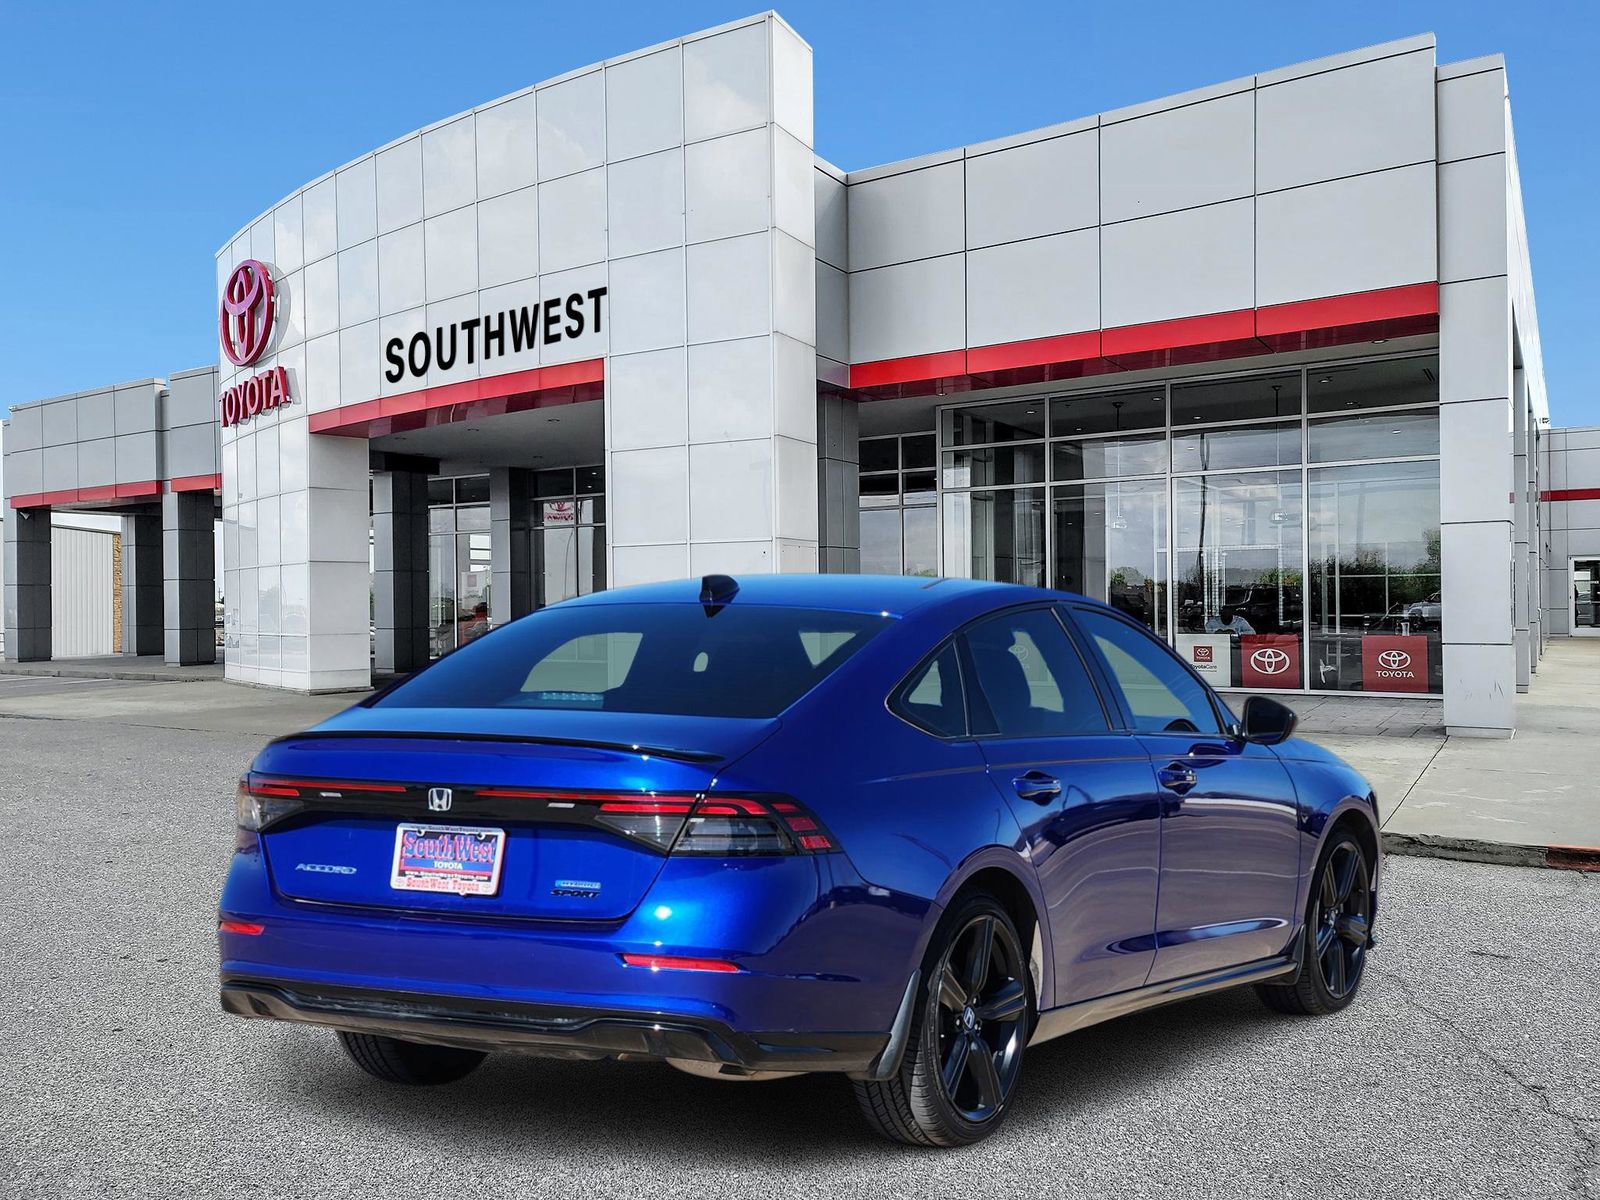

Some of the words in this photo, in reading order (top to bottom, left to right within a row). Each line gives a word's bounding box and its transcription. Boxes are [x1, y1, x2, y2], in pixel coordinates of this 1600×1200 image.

[385, 287, 607, 383] SOUTHWEST
[219, 366, 291, 428] TOYOTA
[1376, 670, 1414, 678] TOYOTA
[295, 863, 357, 874] ACCORD
[433, 861, 463, 870] TOYOTA
[551, 889, 600, 898] SPORT
